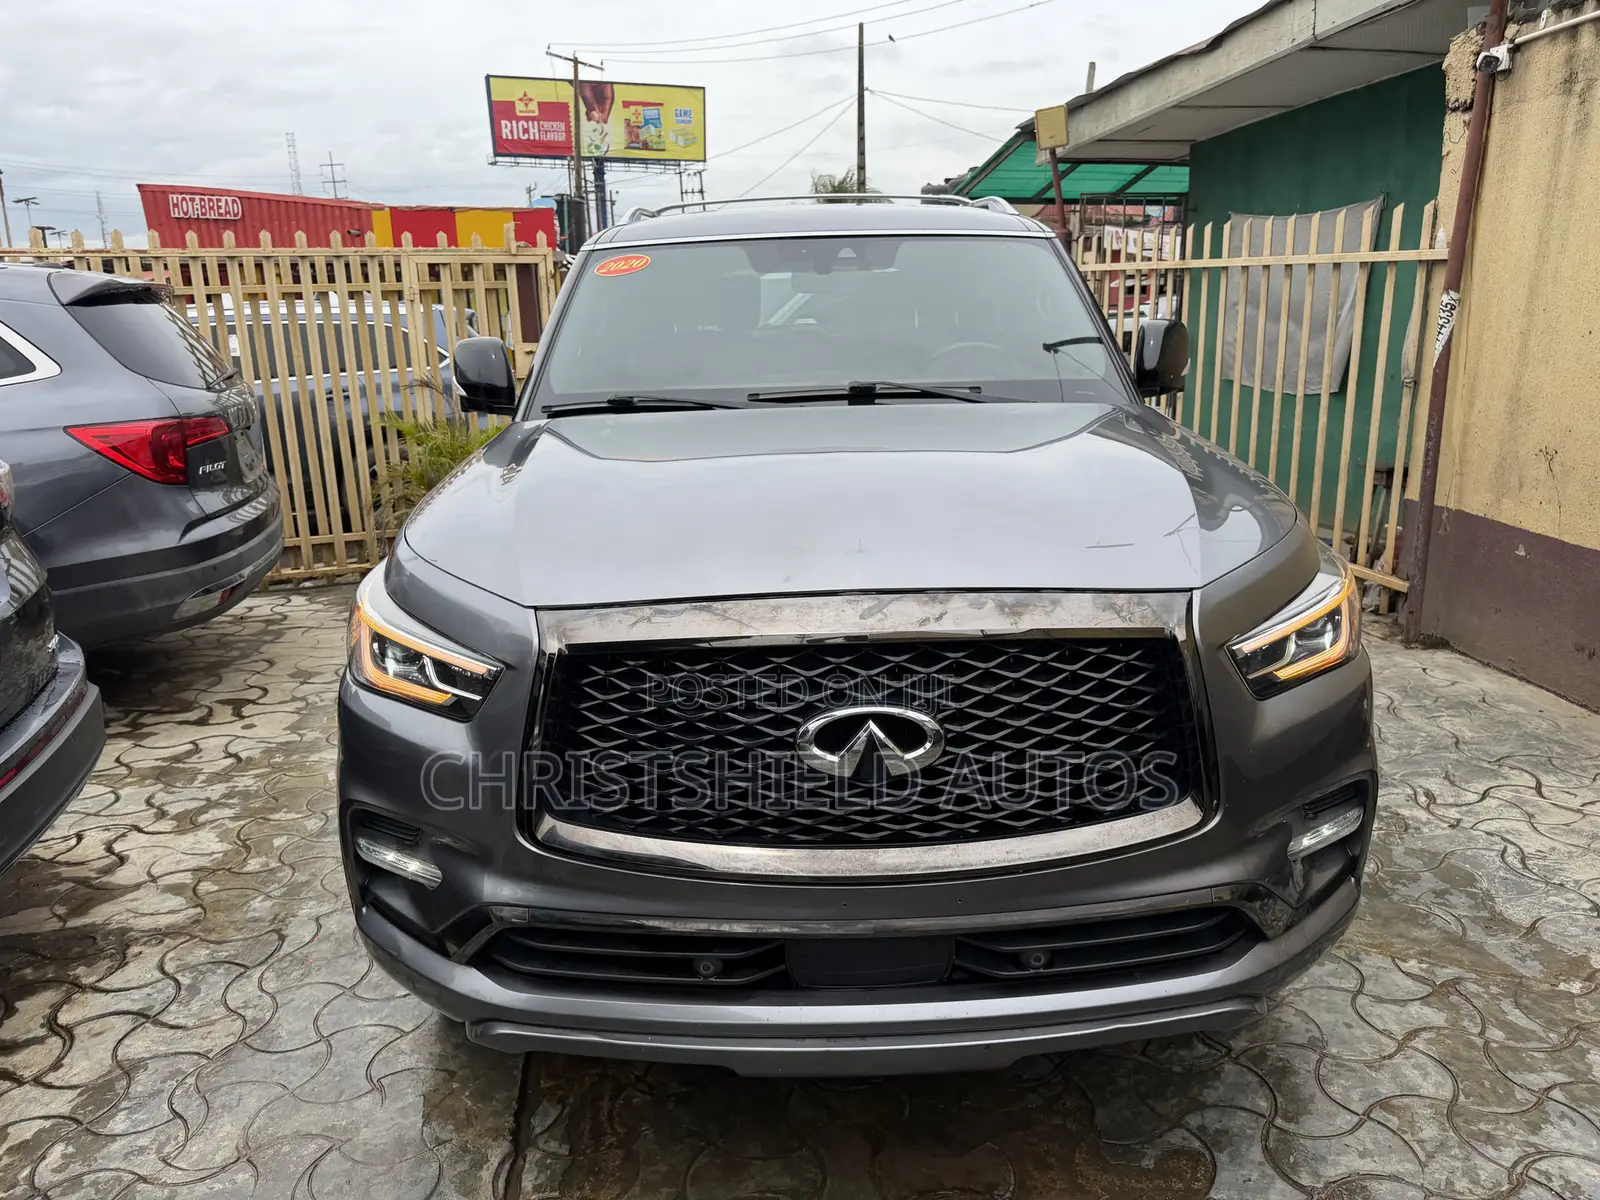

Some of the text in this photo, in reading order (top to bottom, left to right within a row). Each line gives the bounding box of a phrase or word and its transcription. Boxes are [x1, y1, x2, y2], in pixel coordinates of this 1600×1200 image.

[501, 120, 540, 140] RICH
[540, 121, 565, 131] CHICKEN
[169, 194, 242, 219] HOT BREAD
[598, 258, 648, 273] 2020
[198, 460, 227, 475] PILOT
